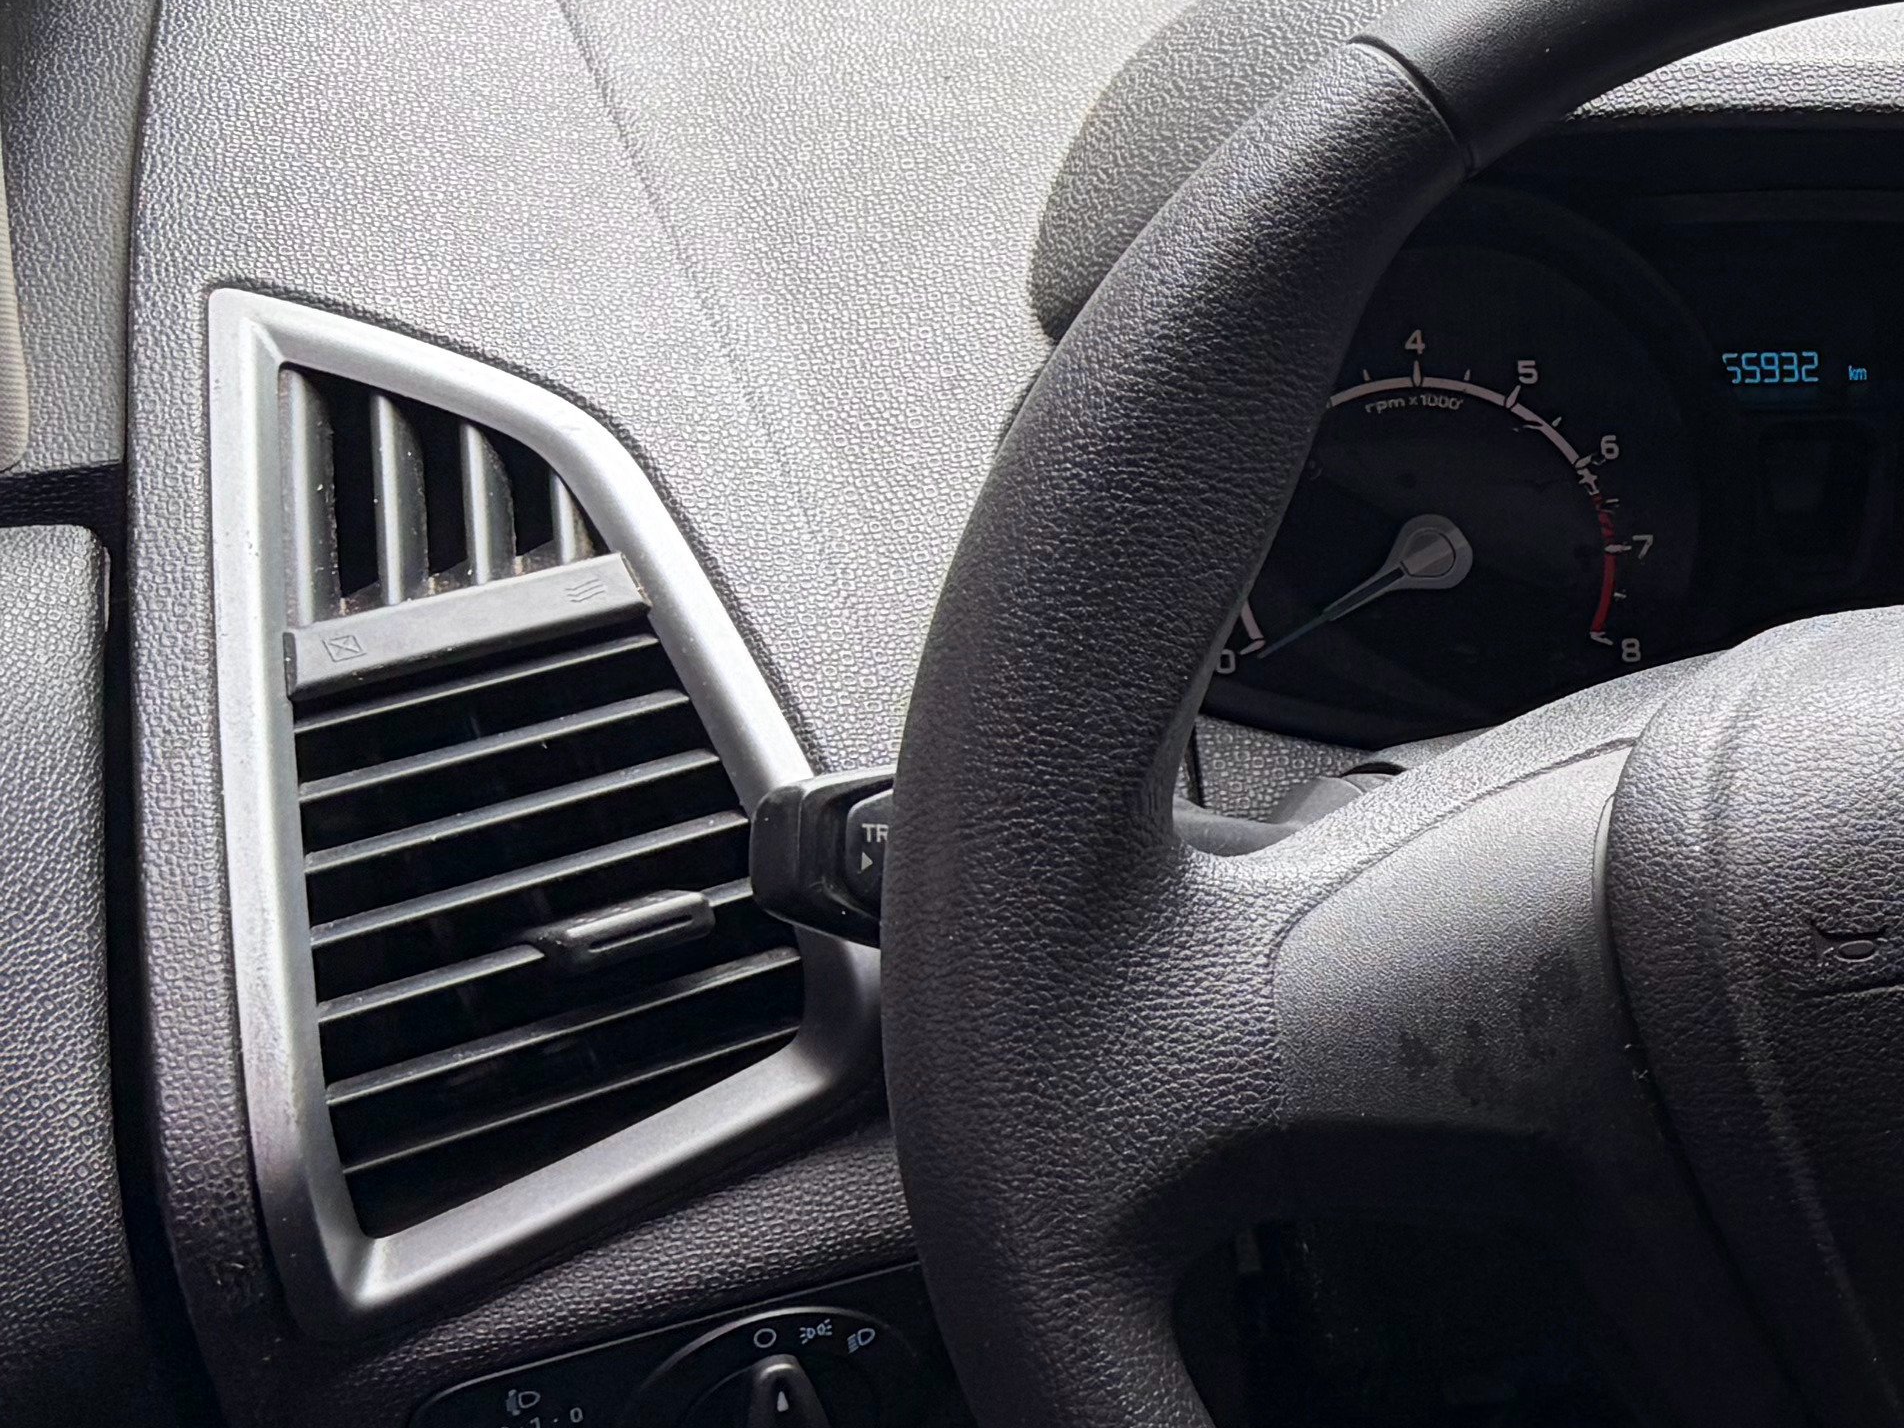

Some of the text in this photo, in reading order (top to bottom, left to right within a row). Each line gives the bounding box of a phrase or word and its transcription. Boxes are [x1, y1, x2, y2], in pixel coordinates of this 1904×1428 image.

[1404, 329, 1426, 355] 4
[1516, 359, 1539, 385] 5
[1722, 351, 1868, 384] 55932 km
[1364, 396, 1406, 414] rpm
[1599, 434, 1621, 461] 6
[1632, 533, 1654, 560] 7
[1216, 649, 1237, 674] 0
[1620, 637, 1642, 663] 8
[569, 1406, 584, 1424] 0
